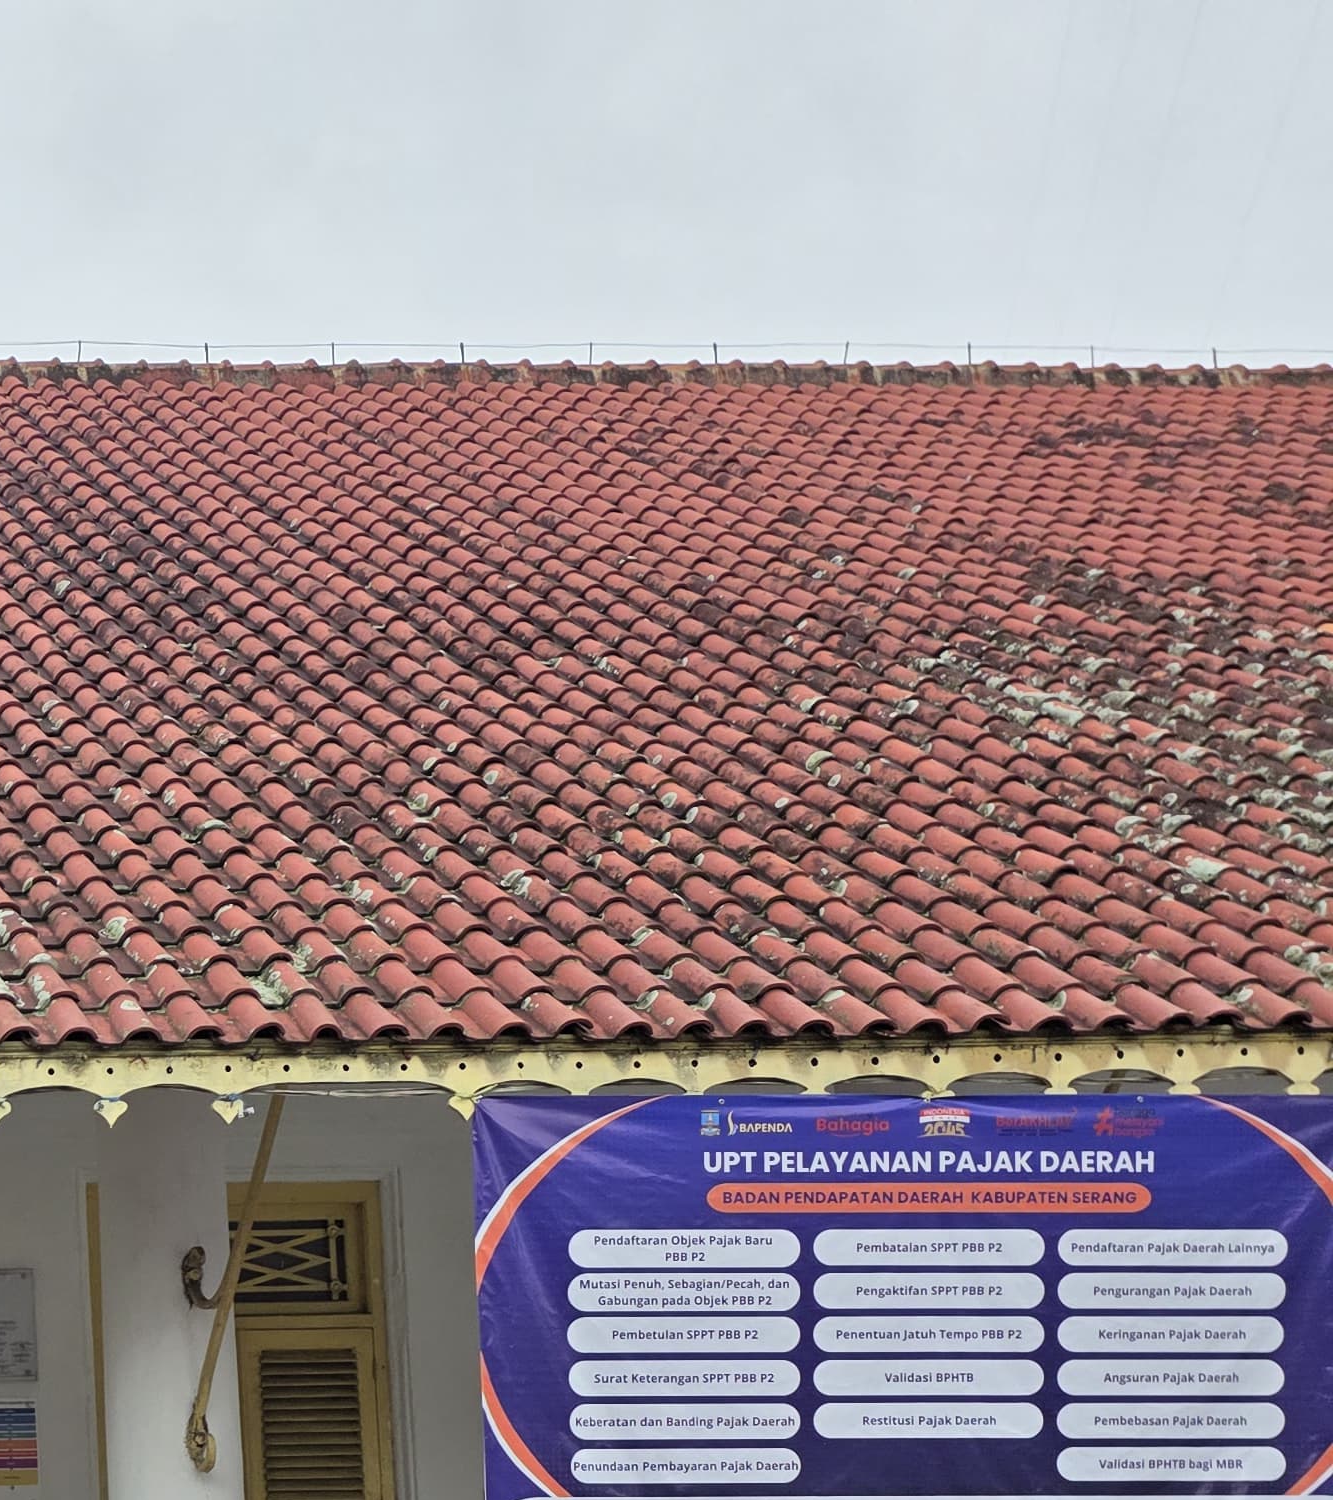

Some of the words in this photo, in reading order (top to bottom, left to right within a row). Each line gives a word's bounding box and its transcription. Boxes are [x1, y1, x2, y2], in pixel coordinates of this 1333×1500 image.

[740, 1122, 792, 1134] BAPENDA
[817, 1118, 889, 1137] Bahagia
[924, 1121, 965, 1137] 2045
[704, 1152, 757, 1172] UPT
[764, 1151, 931, 1172] PELAYANAN
[940, 1151, 1032, 1172] PAJAK
[1041, 1151, 1154, 1172] DAERAH
[723, 1192, 779, 1203] BADAN
[785, 1192, 893, 1203] PENDAPATAN
[898, 1192, 963, 1203] DAERAH
[972, 1192, 1067, 1203] KABUPATEN
[1073, 1192, 1136, 1203] SERANG
[595, 1236, 667, 1245] Pendaftaran
[672, 1236, 705, 1247] Objek
[710, 1236, 741, 1247] Pajak
[746, 1236, 772, 1245] Baru
[857, 1243, 927, 1252] Pembatalan
[931, 1243, 958, 1252] SPPT
[962, 1243, 984, 1252] PBB
[989, 1243, 1002, 1252] P2
[1072, 1243, 1143, 1252] Pendaftaran
[1148, 1243, 1179, 1255] Pajak
[1183, 1243, 1224, 1252] Daerah
[1229, 1243, 1274, 1255] Lainnya
[666, 1253, 687, 1261] PBB
[692, 1253, 705, 1261] P2
[580, 1280, 620, 1289] Mutasi
[625, 1280, 664, 1290] Penuh,
[668, 1279, 764, 1291] Sebagian/Pecah,
[768, 1280, 789, 1288] dan
[857, 1286, 927, 1298] Pengaktifan
[932, 1286, 958, 1295] SPPT
[962, 1287, 984, 1295] PBB
[989, 1287, 1002, 1295] P2
[1094, 1287, 1170, 1298] Pengurangan
[1175, 1286, 1205, 1298] Pajak
[1210, 1286, 1252, 1295] Daerah
[598, 1296, 658, 1307] Gabungan
[662, 1296, 690, 1307] pada
[695, 1296, 728, 1307] Objek
[732, 1296, 754, 1305] PBB
[759, 1296, 771, 1305] P2
[613, 1330, 683, 1339] Pembetulan
[687, 1330, 714, 1339] SPPT
[719, 1330, 740, 1339] PBB
[745, 1330, 757, 1339] P2
[837, 1330, 900, 1339] Penentuan
[903, 1330, 936, 1341] Jatuh
[940, 1330, 978, 1341] Tempo
[982, 1330, 1004, 1339] PBB
[1008, 1330, 1021, 1339] P2
[1099, 1330, 1165, 1341] Keringanan
[1169, 1330, 1200, 1341] Pajak
[1205, 1330, 1246, 1339] Daerah
[595, 1374, 627, 1383] Surat
[632, 1374, 699, 1385] Keterangan
[703, 1374, 730, 1383] SPPT
[735, 1374, 756, 1382] PBB
[761, 1374, 774, 1382] P2
[885, 1373, 932, 1382] Validasi
[937, 1373, 973, 1382] BPHTB
[1104, 1373, 1159, 1385] Angsuran
[1163, 1373, 1194, 1385] Pajak
[1199, 1373, 1239, 1382] Daerah
[576, 1418, 636, 1427] Keberatan
[640, 1418, 662, 1426] dan
[667, 1417, 713, 1429] Banding
[717, 1417, 748, 1429] Pajak
[753, 1417, 794, 1426] Daerah
[863, 1416, 914, 1425] Restitusi
[919, 1416, 951, 1428] Pajak
[956, 1416, 996, 1425] Daerah
[1095, 1416, 1169, 1425] Pembebasan
[1173, 1416, 1203, 1428] Pajak
[1207, 1416, 1246, 1425] Daerah
[573, 1462, 638, 1471] Penundaan
[643, 1462, 716, 1473] Pembayaran
[721, 1461, 752, 1473] Pajak
[757, 1462, 798, 1471] Daerah
[1099, 1459, 1144, 1469] Validasi
[1149, 1460, 1185, 1468] BPHTB
[1189, 1460, 1212, 1471] bagi
[1217, 1460, 1242, 1468] MBR
